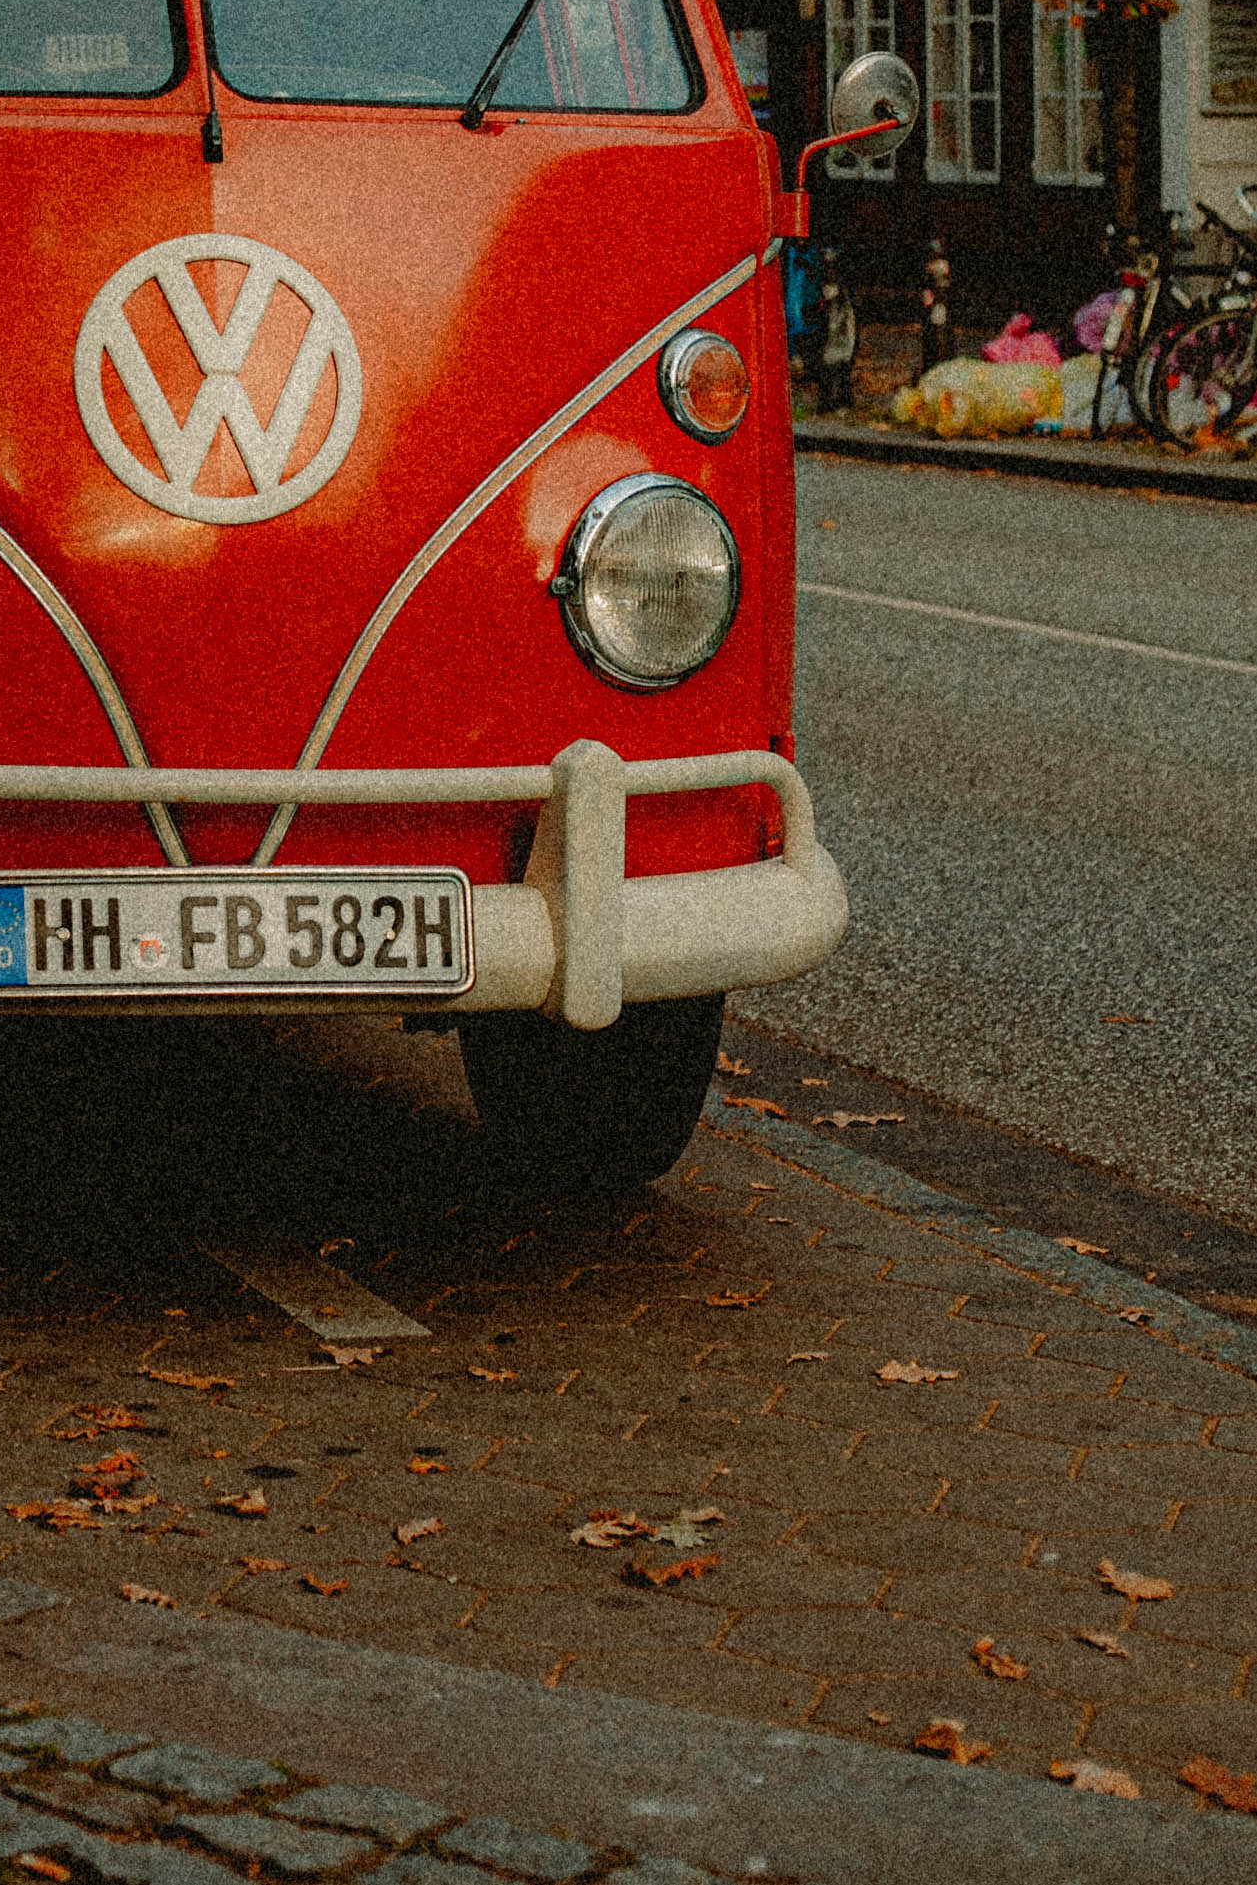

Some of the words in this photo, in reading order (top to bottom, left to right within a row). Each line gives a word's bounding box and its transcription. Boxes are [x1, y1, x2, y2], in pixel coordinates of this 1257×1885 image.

[76, 235, 362, 524] VW
[33, 898, 122, 972] HH
[179, 896, 267, 969] FB
[285, 894, 453, 969] 582H
